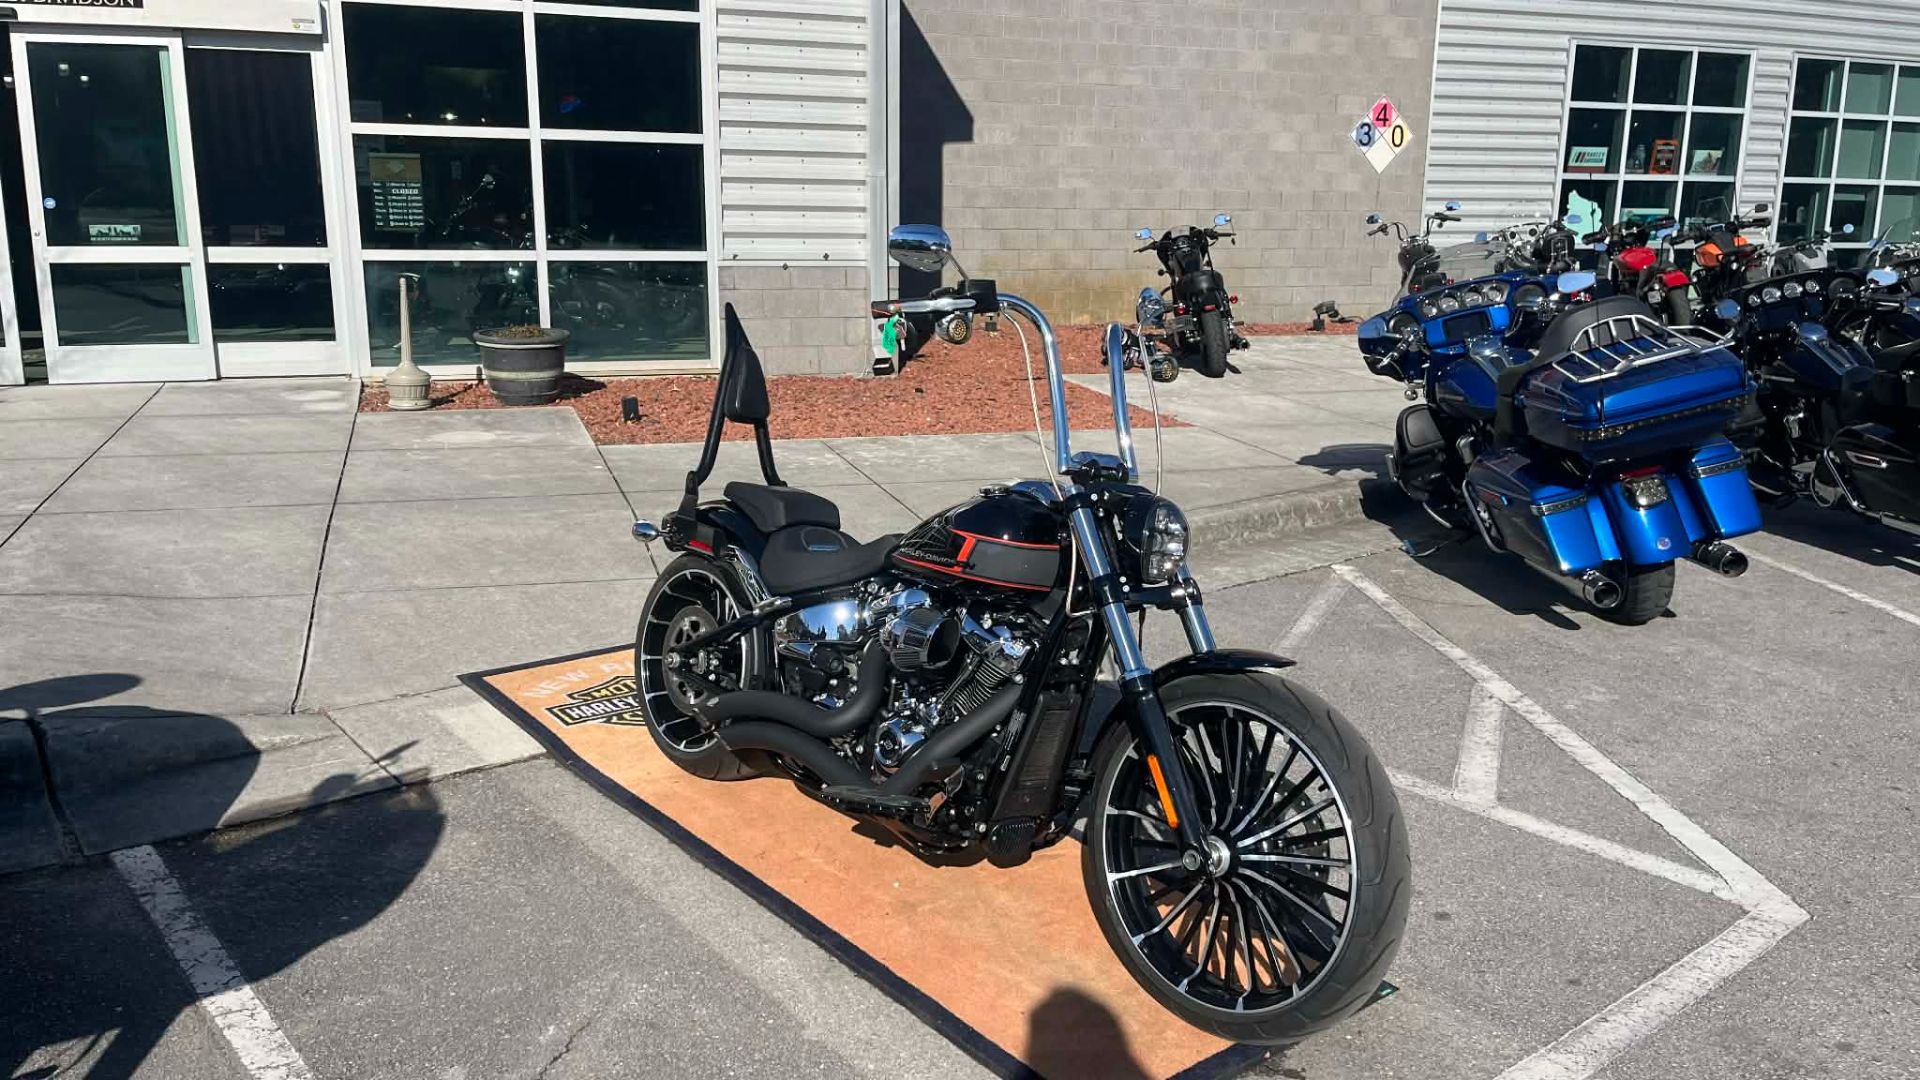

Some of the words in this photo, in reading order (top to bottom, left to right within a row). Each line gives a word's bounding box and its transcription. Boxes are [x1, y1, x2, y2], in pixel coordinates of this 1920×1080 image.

[1375, 104, 1389, 127] 4
[1358, 122, 1372, 147] 3
[1391, 124, 1404, 148] 0
[523, 670, 590, 698] NEW
